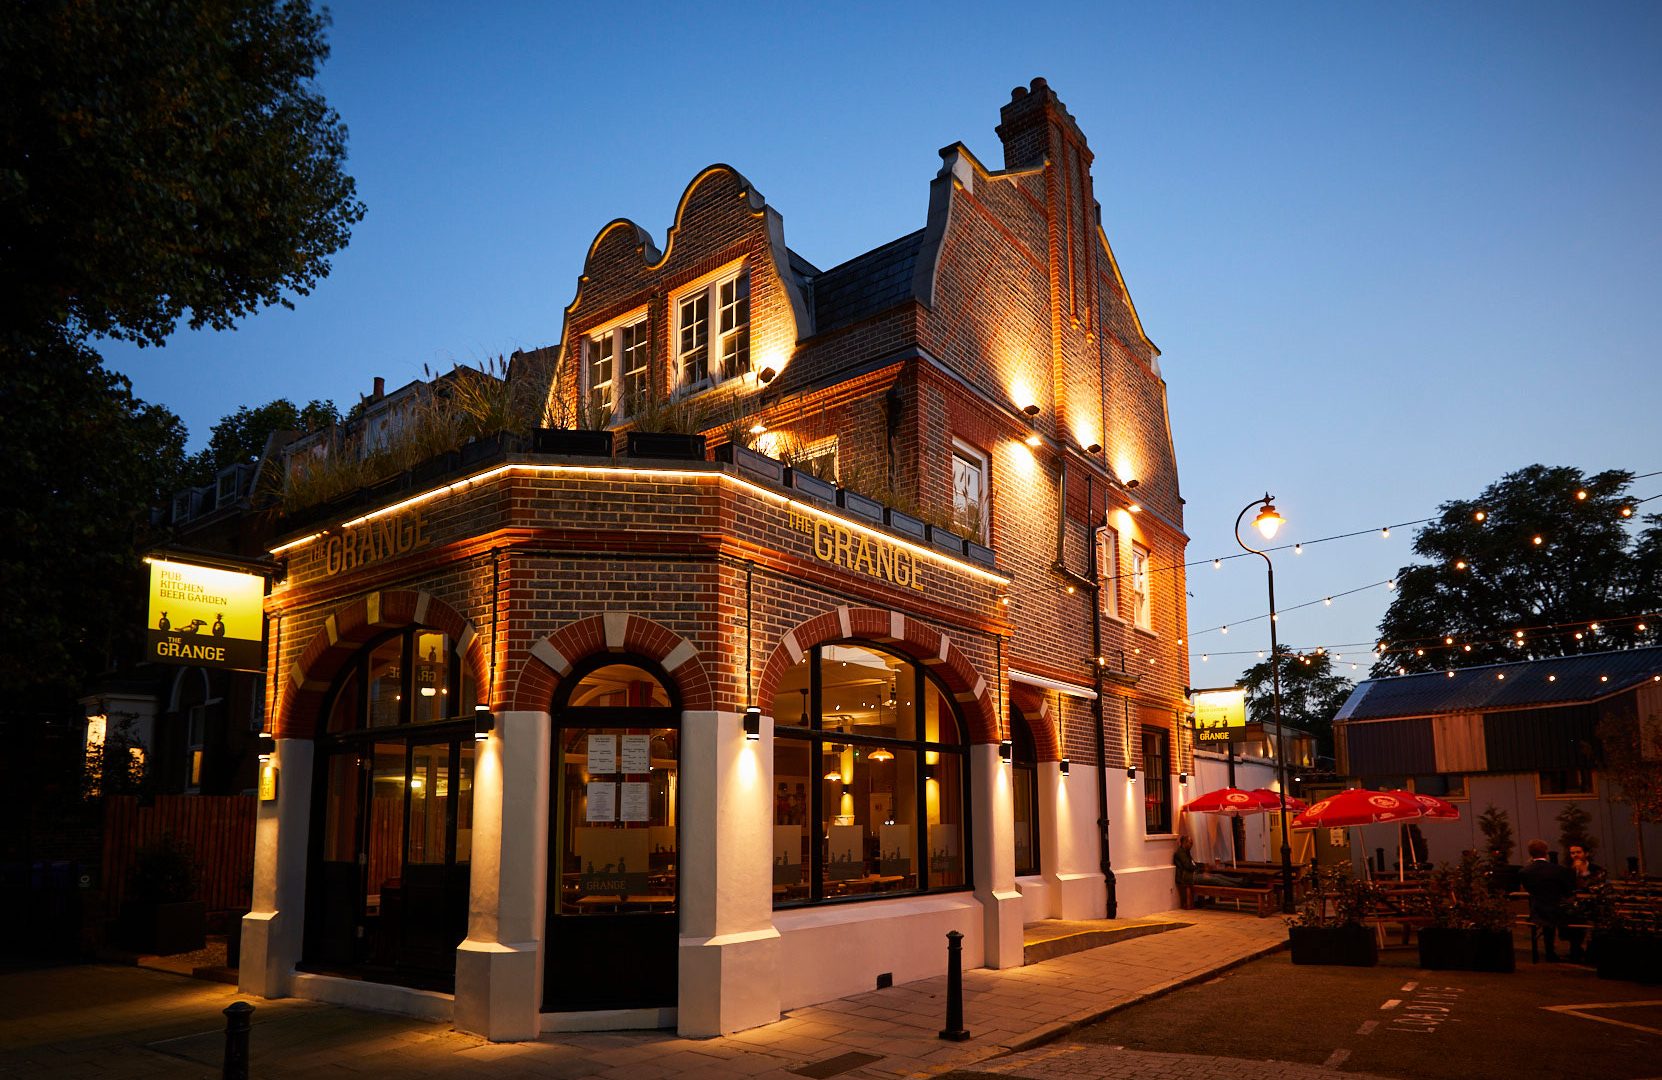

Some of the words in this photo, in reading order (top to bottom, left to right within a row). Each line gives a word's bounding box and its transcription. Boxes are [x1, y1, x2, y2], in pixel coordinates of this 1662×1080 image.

[310, 540, 326, 562] THE
[326, 508, 431, 576] GRANGE
[786, 511, 813, 535] THE
[814, 519, 925, 592] GRANGE
[160, 570, 182, 582] PUB
[160, 580, 204, 594] KITCHEN
[160, 589, 186, 601] BEER
[187, 592, 228, 606] GARDEN
[167, 636, 182, 644] THE
[156, 641, 226, 662] GRANGE
[1199, 731, 1230, 741] GRANGE
[586, 880, 626, 891] GRANGE
